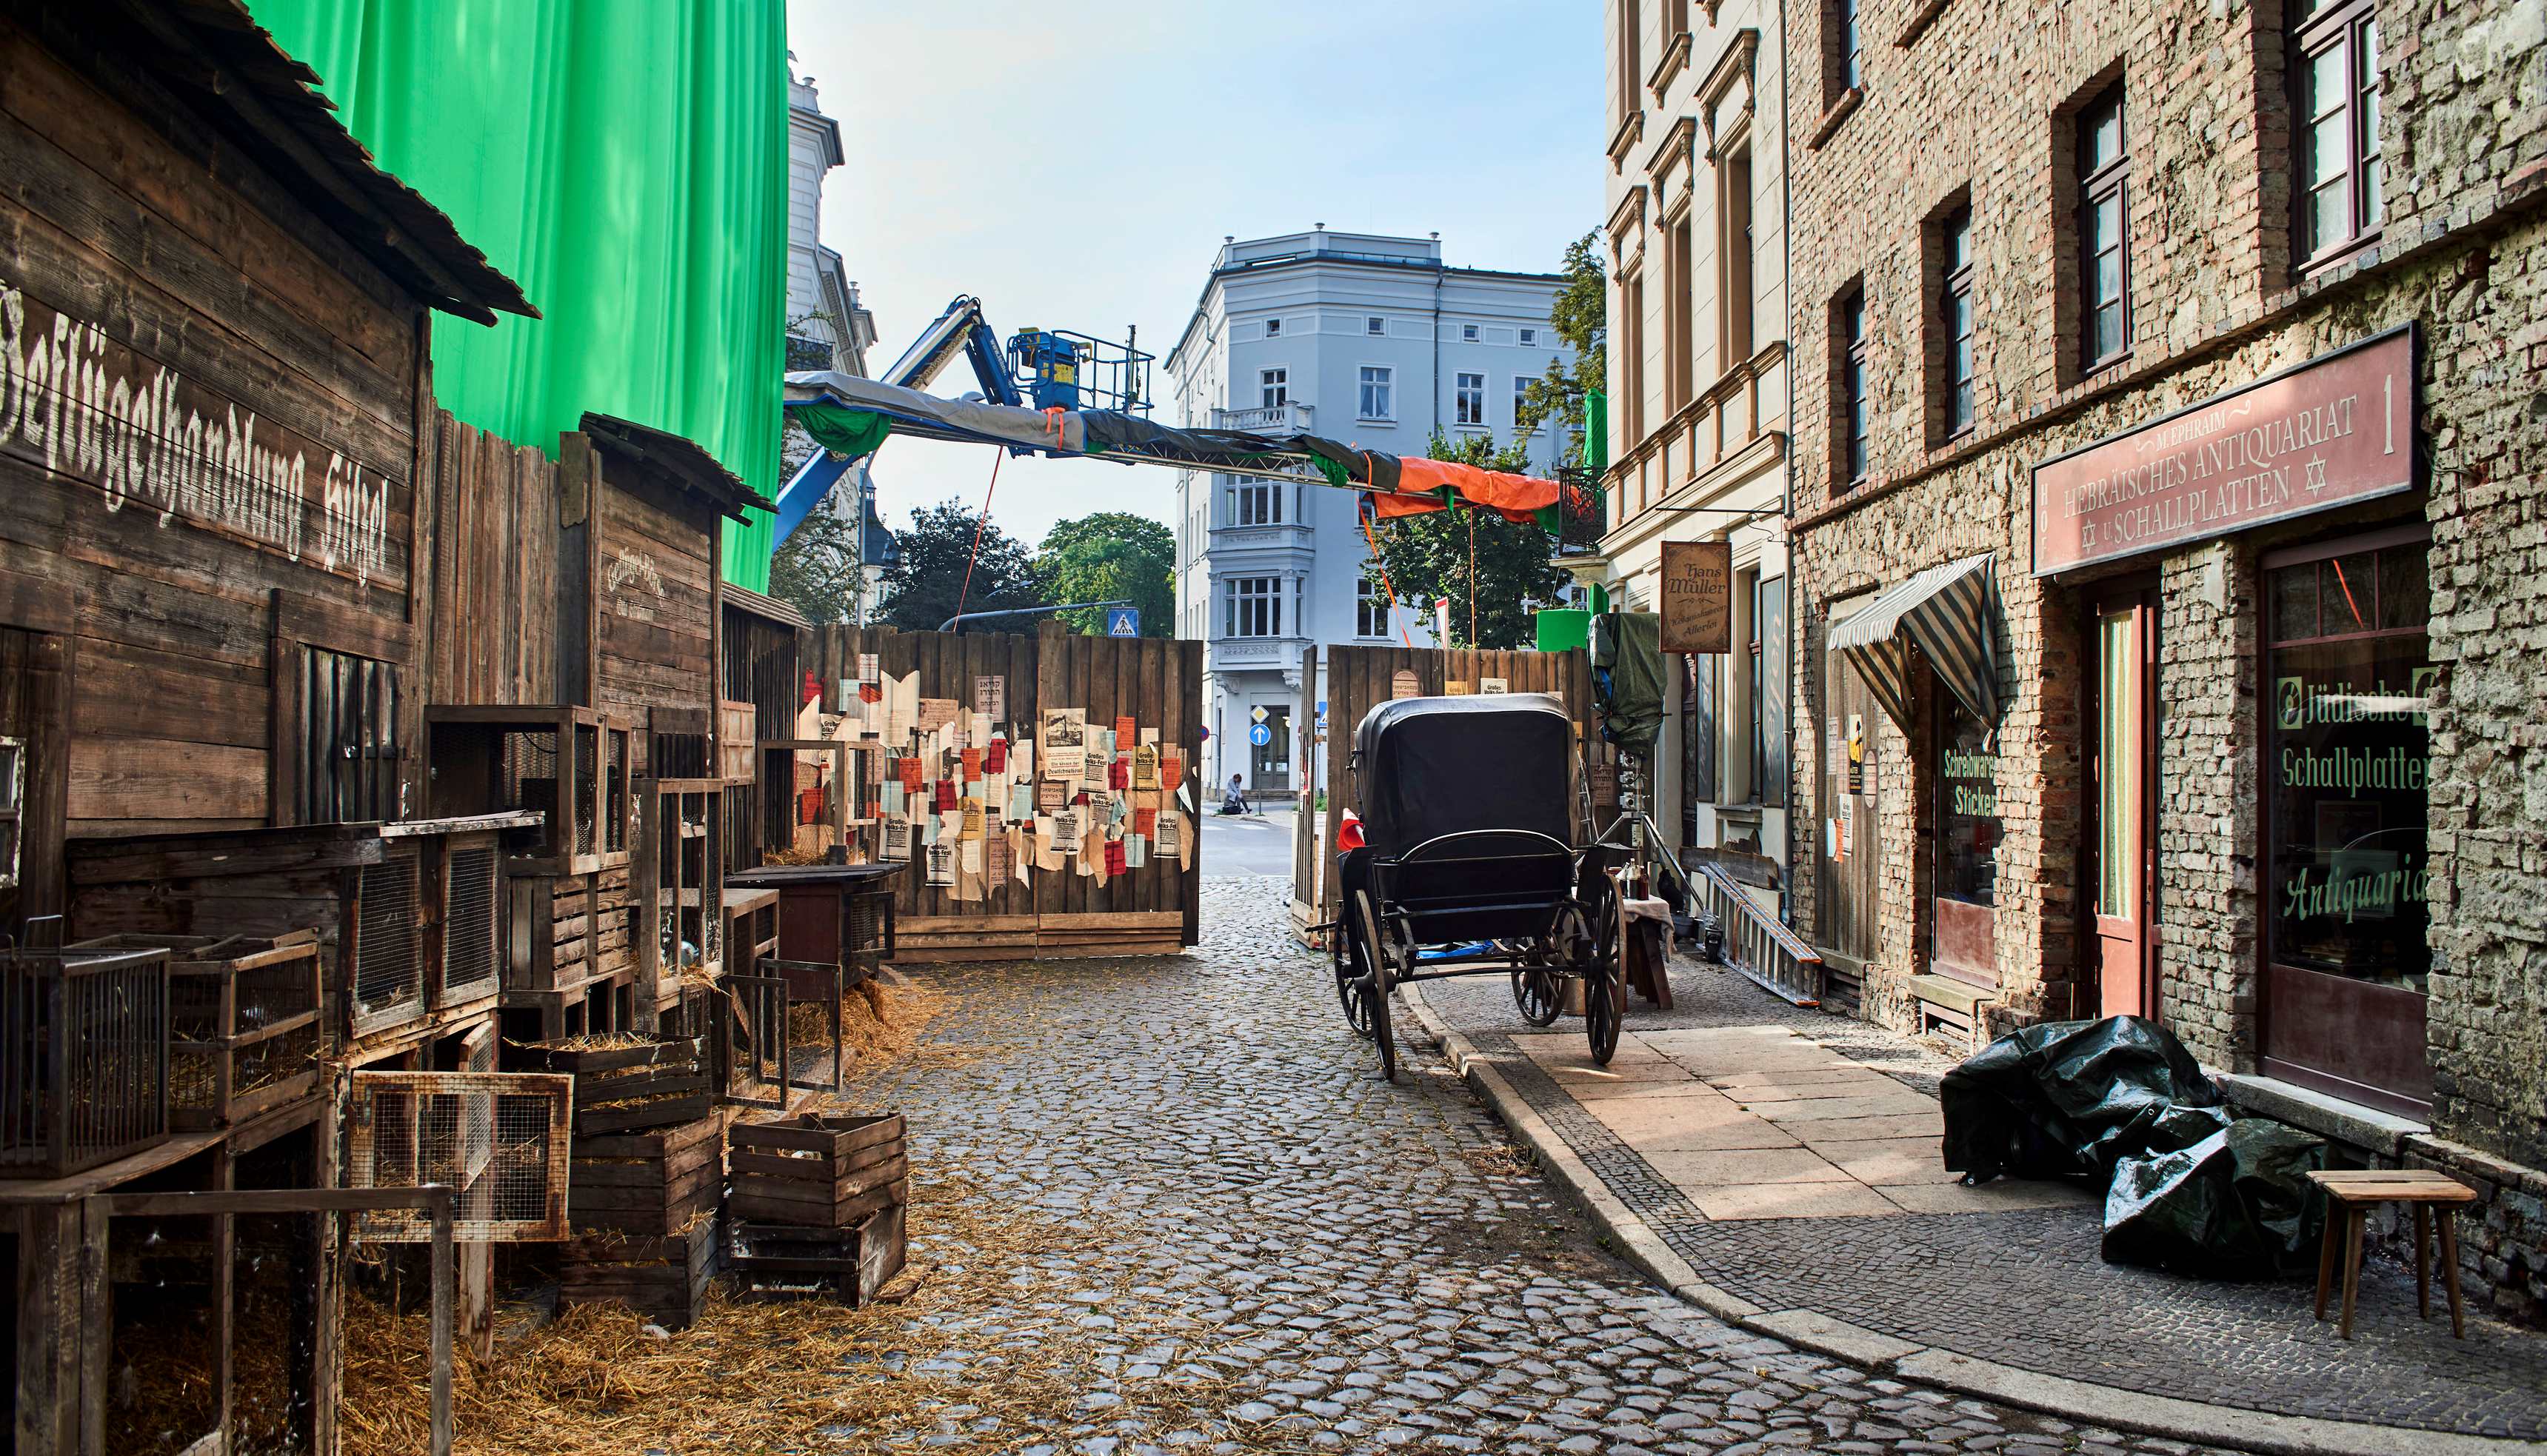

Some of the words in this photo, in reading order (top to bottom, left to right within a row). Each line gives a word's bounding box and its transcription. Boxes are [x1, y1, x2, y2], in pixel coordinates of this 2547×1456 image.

[2063, 451, 2187, 518] HEBRÄISCHES
[2192, 394, 2357, 481] ANTIQUARIAT
[2114, 465, 2290, 544] SCHALLPLATTEN
[1668, 578, 1726, 594] Müller
[1684, 564, 1722, 581] Hans
